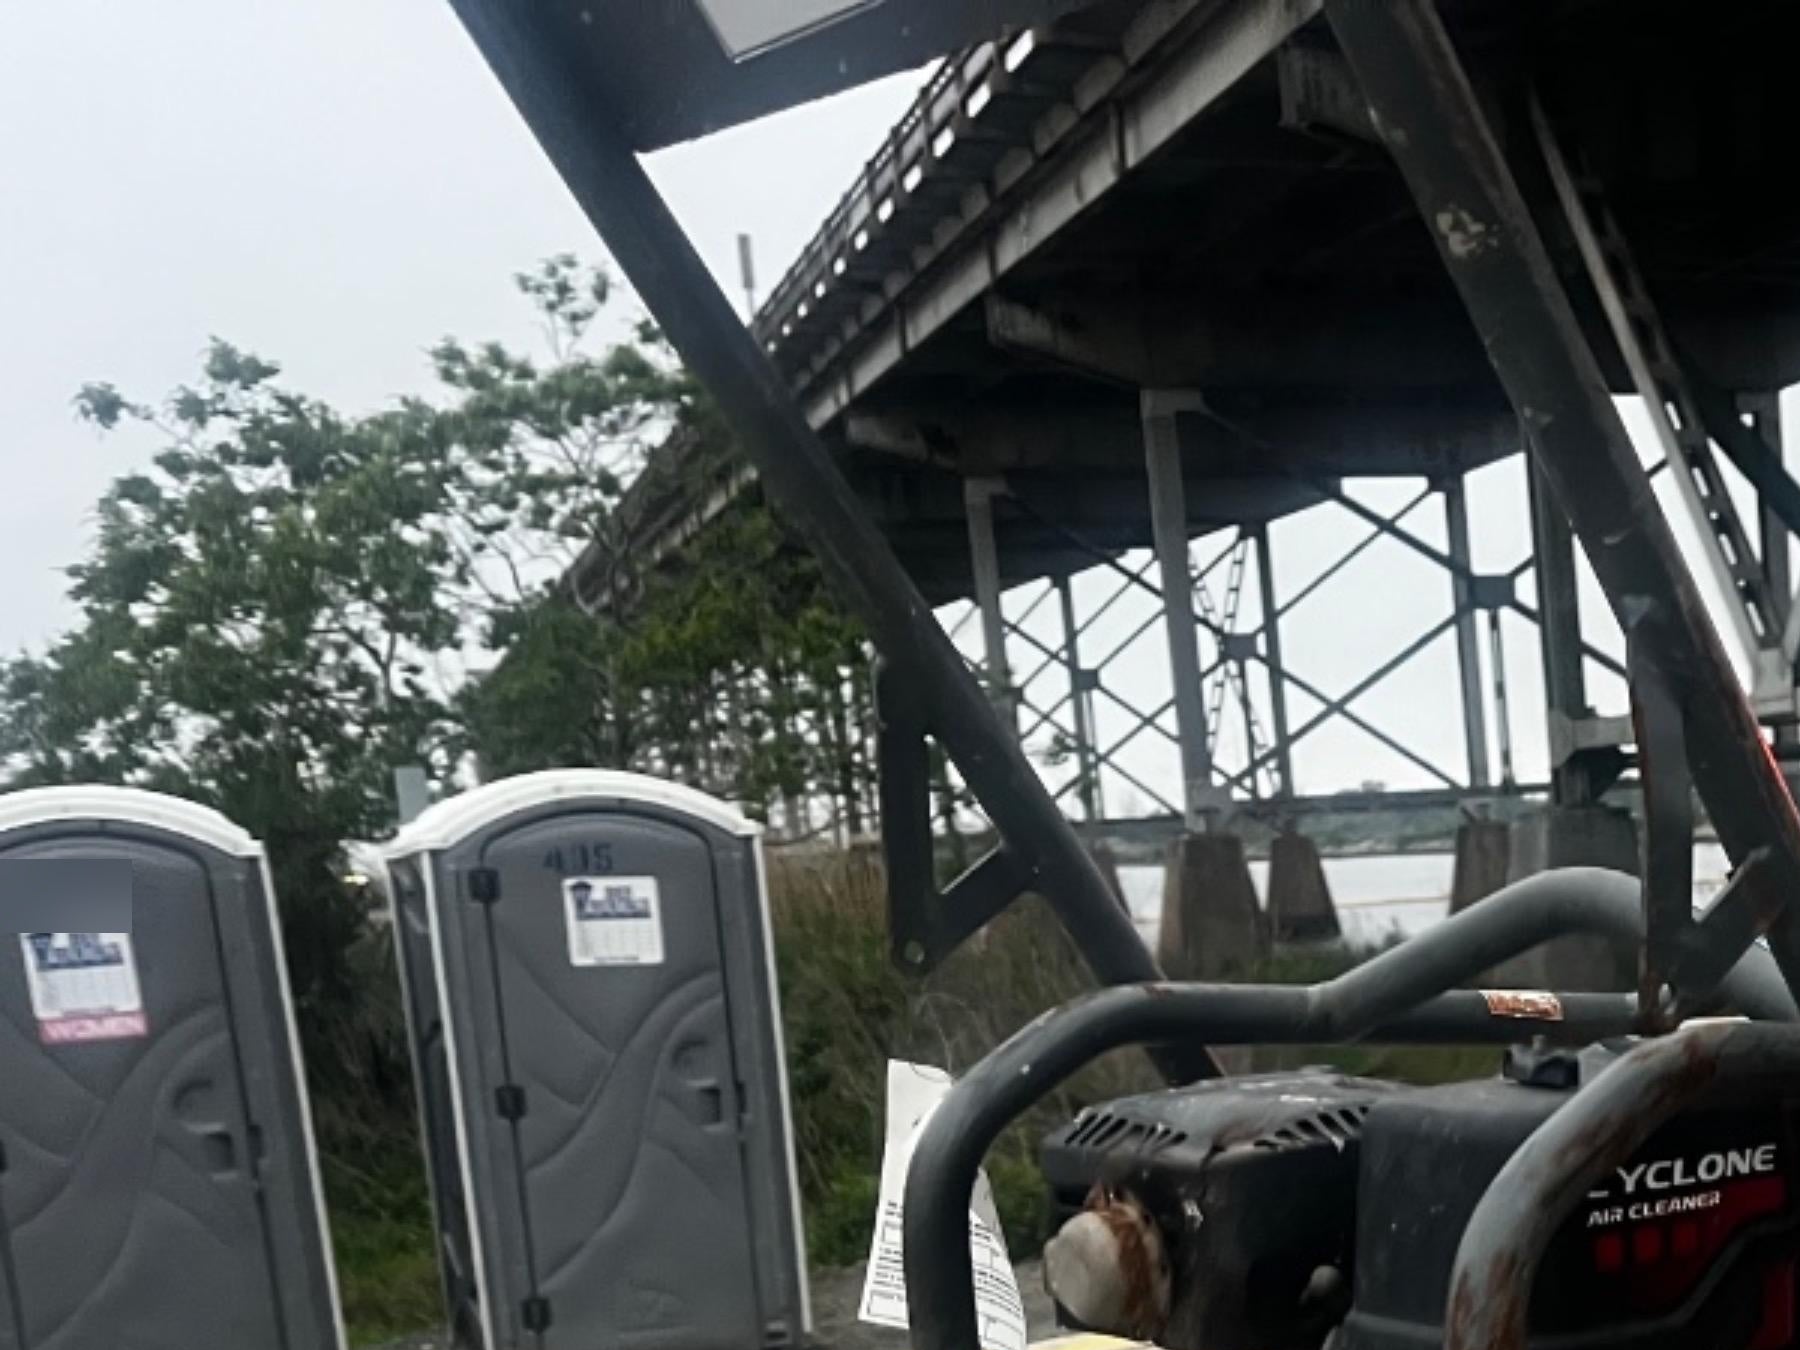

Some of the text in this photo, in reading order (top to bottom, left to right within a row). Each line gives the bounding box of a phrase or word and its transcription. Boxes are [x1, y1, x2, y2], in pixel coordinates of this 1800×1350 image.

[1586, 1144, 1778, 1199] YCLONE
[1586, 1190, 1721, 1228] AIR CLEANER
